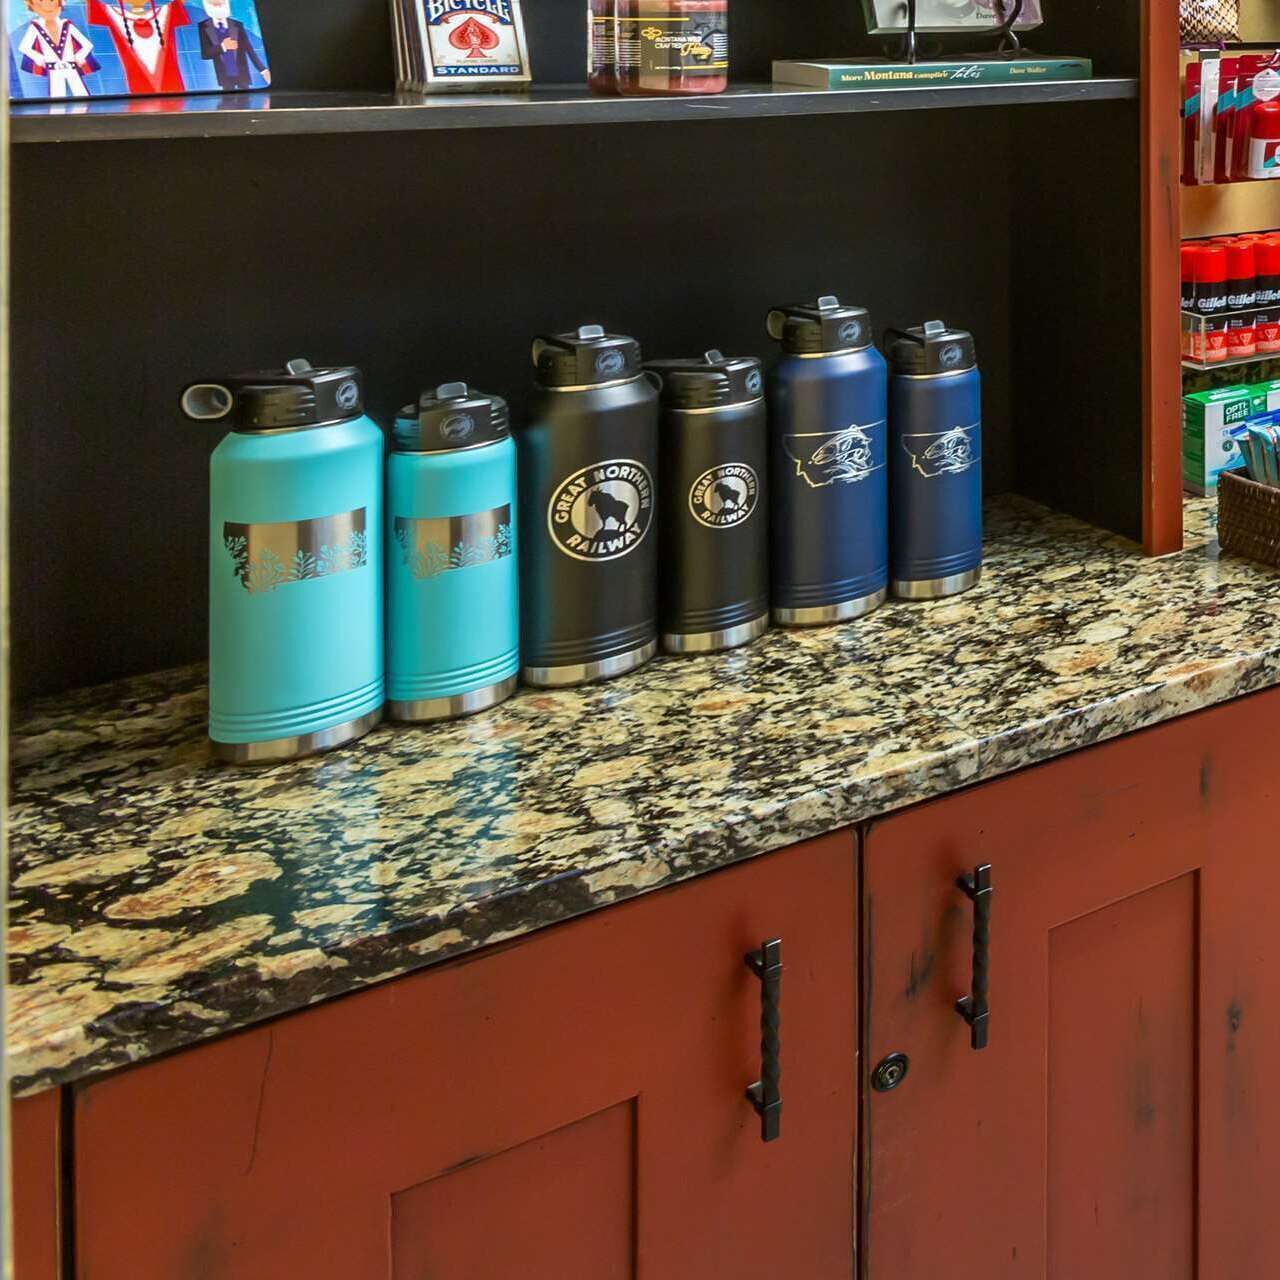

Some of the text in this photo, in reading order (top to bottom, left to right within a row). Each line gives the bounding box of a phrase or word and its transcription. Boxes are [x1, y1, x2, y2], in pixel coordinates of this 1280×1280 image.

[437, 65, 520, 75] STANDARD
[840, 73, 863, 82] More
[863, 70, 914, 81] Montana
[1225, 400, 1249, 415] OPTI-
[1226, 408, 1249, 423] FREE
[555, 466, 650, 523] GREAT NORTHERN
[694, 468, 755, 504] GREAT NORTHERN
[701, 504, 750, 524] RAILWAY
[567, 522, 641, 554] RAILWAY
